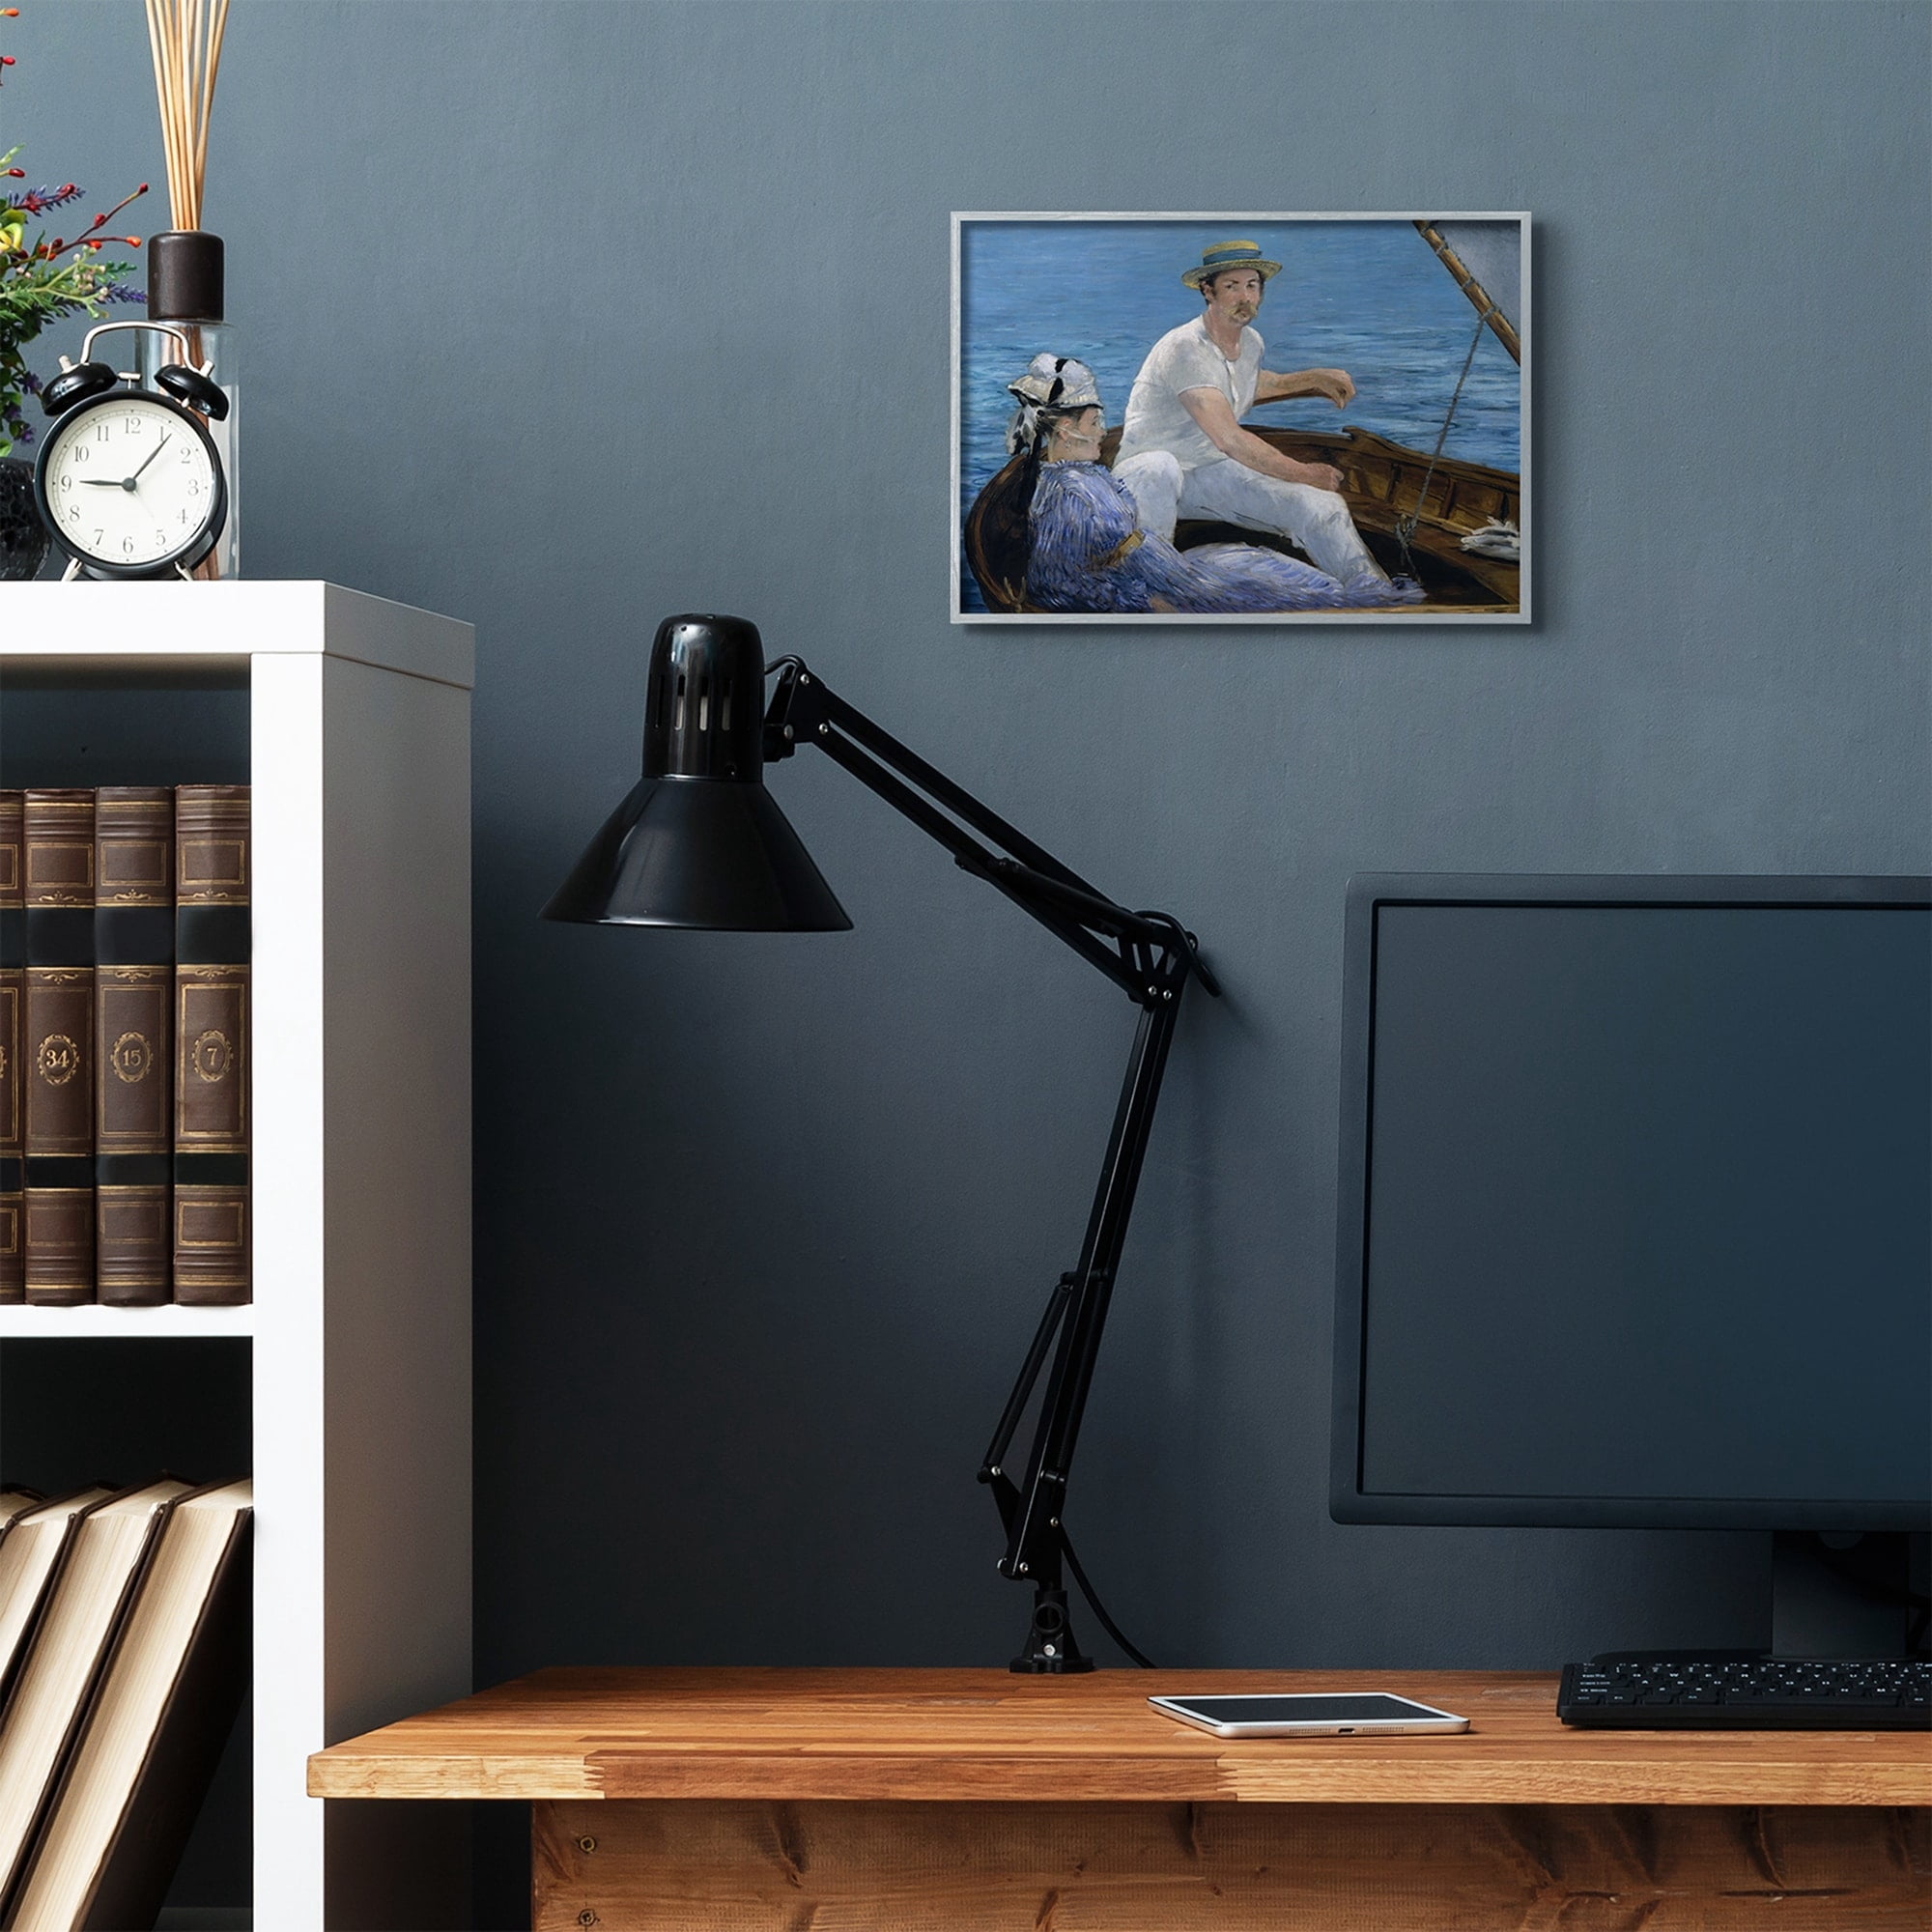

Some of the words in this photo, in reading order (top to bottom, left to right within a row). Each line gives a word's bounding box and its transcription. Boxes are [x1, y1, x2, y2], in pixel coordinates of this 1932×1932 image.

[97, 425, 109, 441] 11
[125, 417, 142, 434] 12
[74, 445, 89, 462] 10
[180, 447, 191, 464] 2
[61, 475, 72, 492] 9
[187, 479, 199, 496] 3
[70, 505, 80, 522] 8
[176, 508, 188, 525] 4
[94, 528, 104, 546] 7
[123, 536, 133, 554] 6
[156, 528, 166, 546] 5
[45, 1049, 70, 1067] 34
[123, 1049, 142, 1066] 15
[206, 1047, 218, 1065] 7
